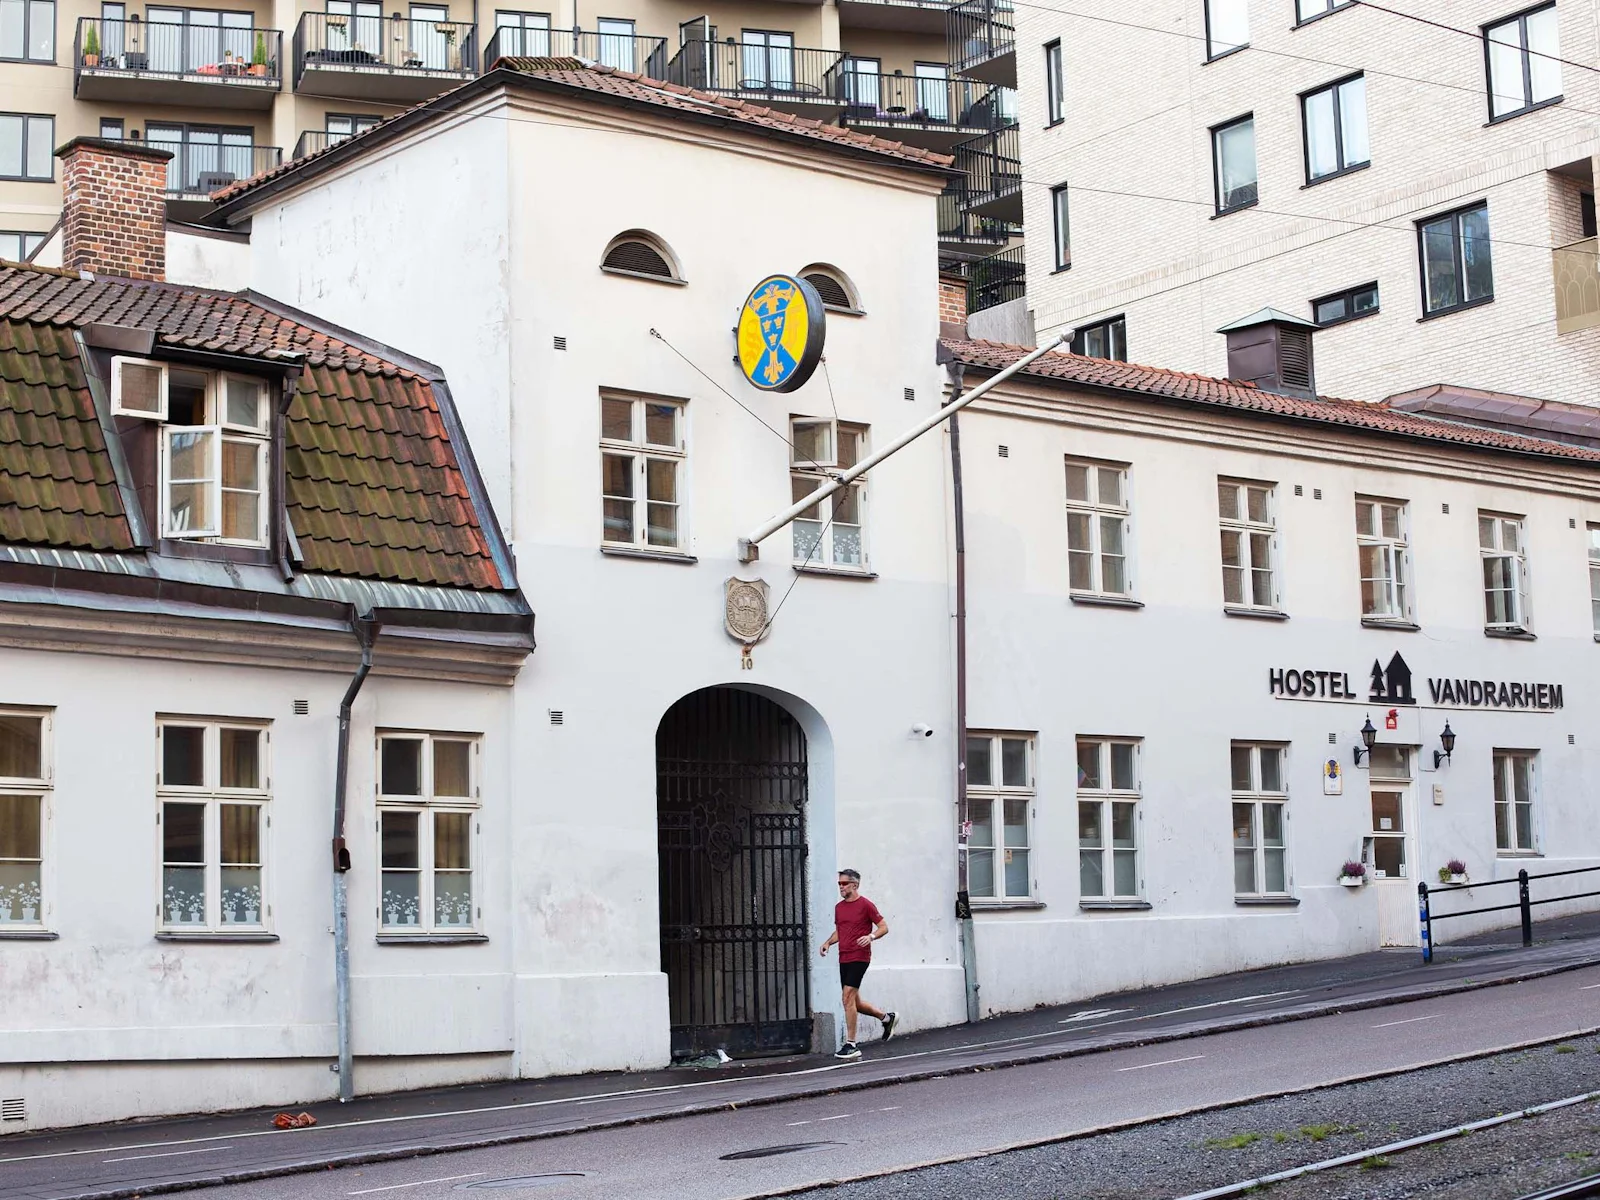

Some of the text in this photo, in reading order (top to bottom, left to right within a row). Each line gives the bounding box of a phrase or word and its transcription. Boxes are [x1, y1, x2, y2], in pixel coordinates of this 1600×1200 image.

[741, 658, 753, 670] 10
[1269, 667, 1564, 710] HOSTEL VANDRARHEM
